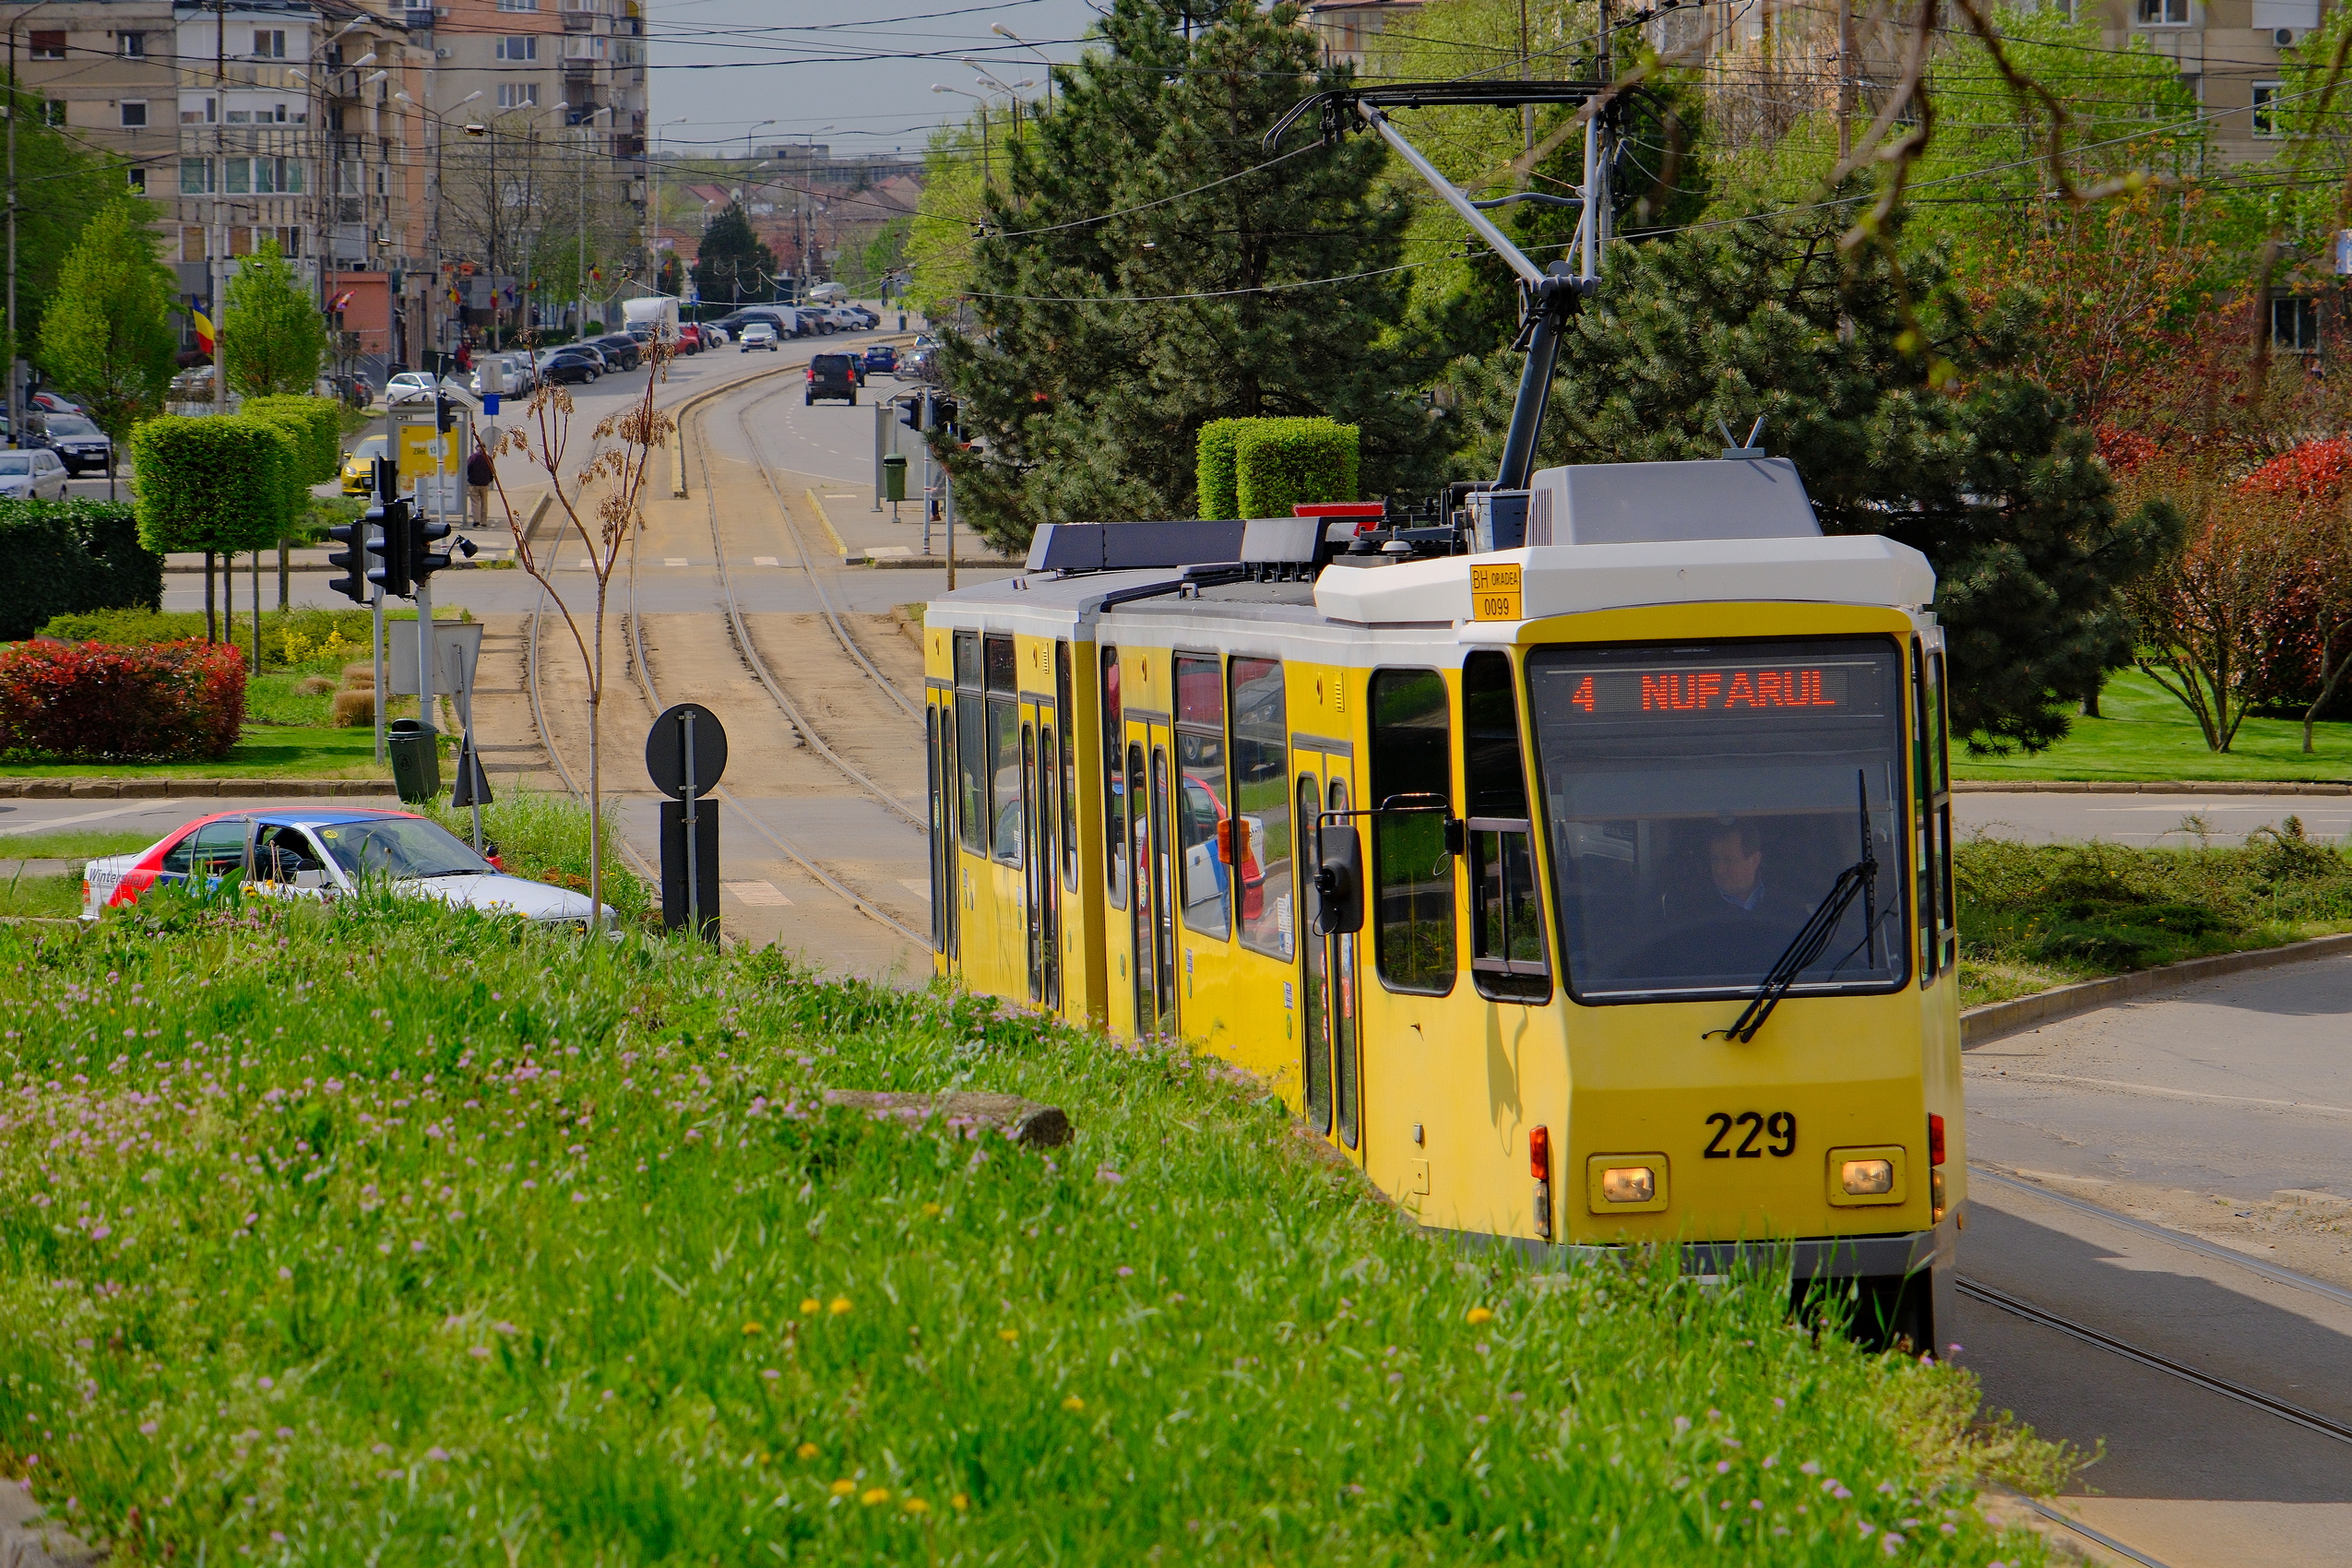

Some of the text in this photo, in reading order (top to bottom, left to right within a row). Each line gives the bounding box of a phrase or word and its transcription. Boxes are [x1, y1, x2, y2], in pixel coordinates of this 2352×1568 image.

[1473, 569, 1519, 588] BH ORADEA
[1484, 598, 1509, 615] 0099
[1572, 671, 1835, 712] 4 NUFARUL
[89, 867, 148, 887] Wintershall
[1704, 1111, 1797, 1158] 229
